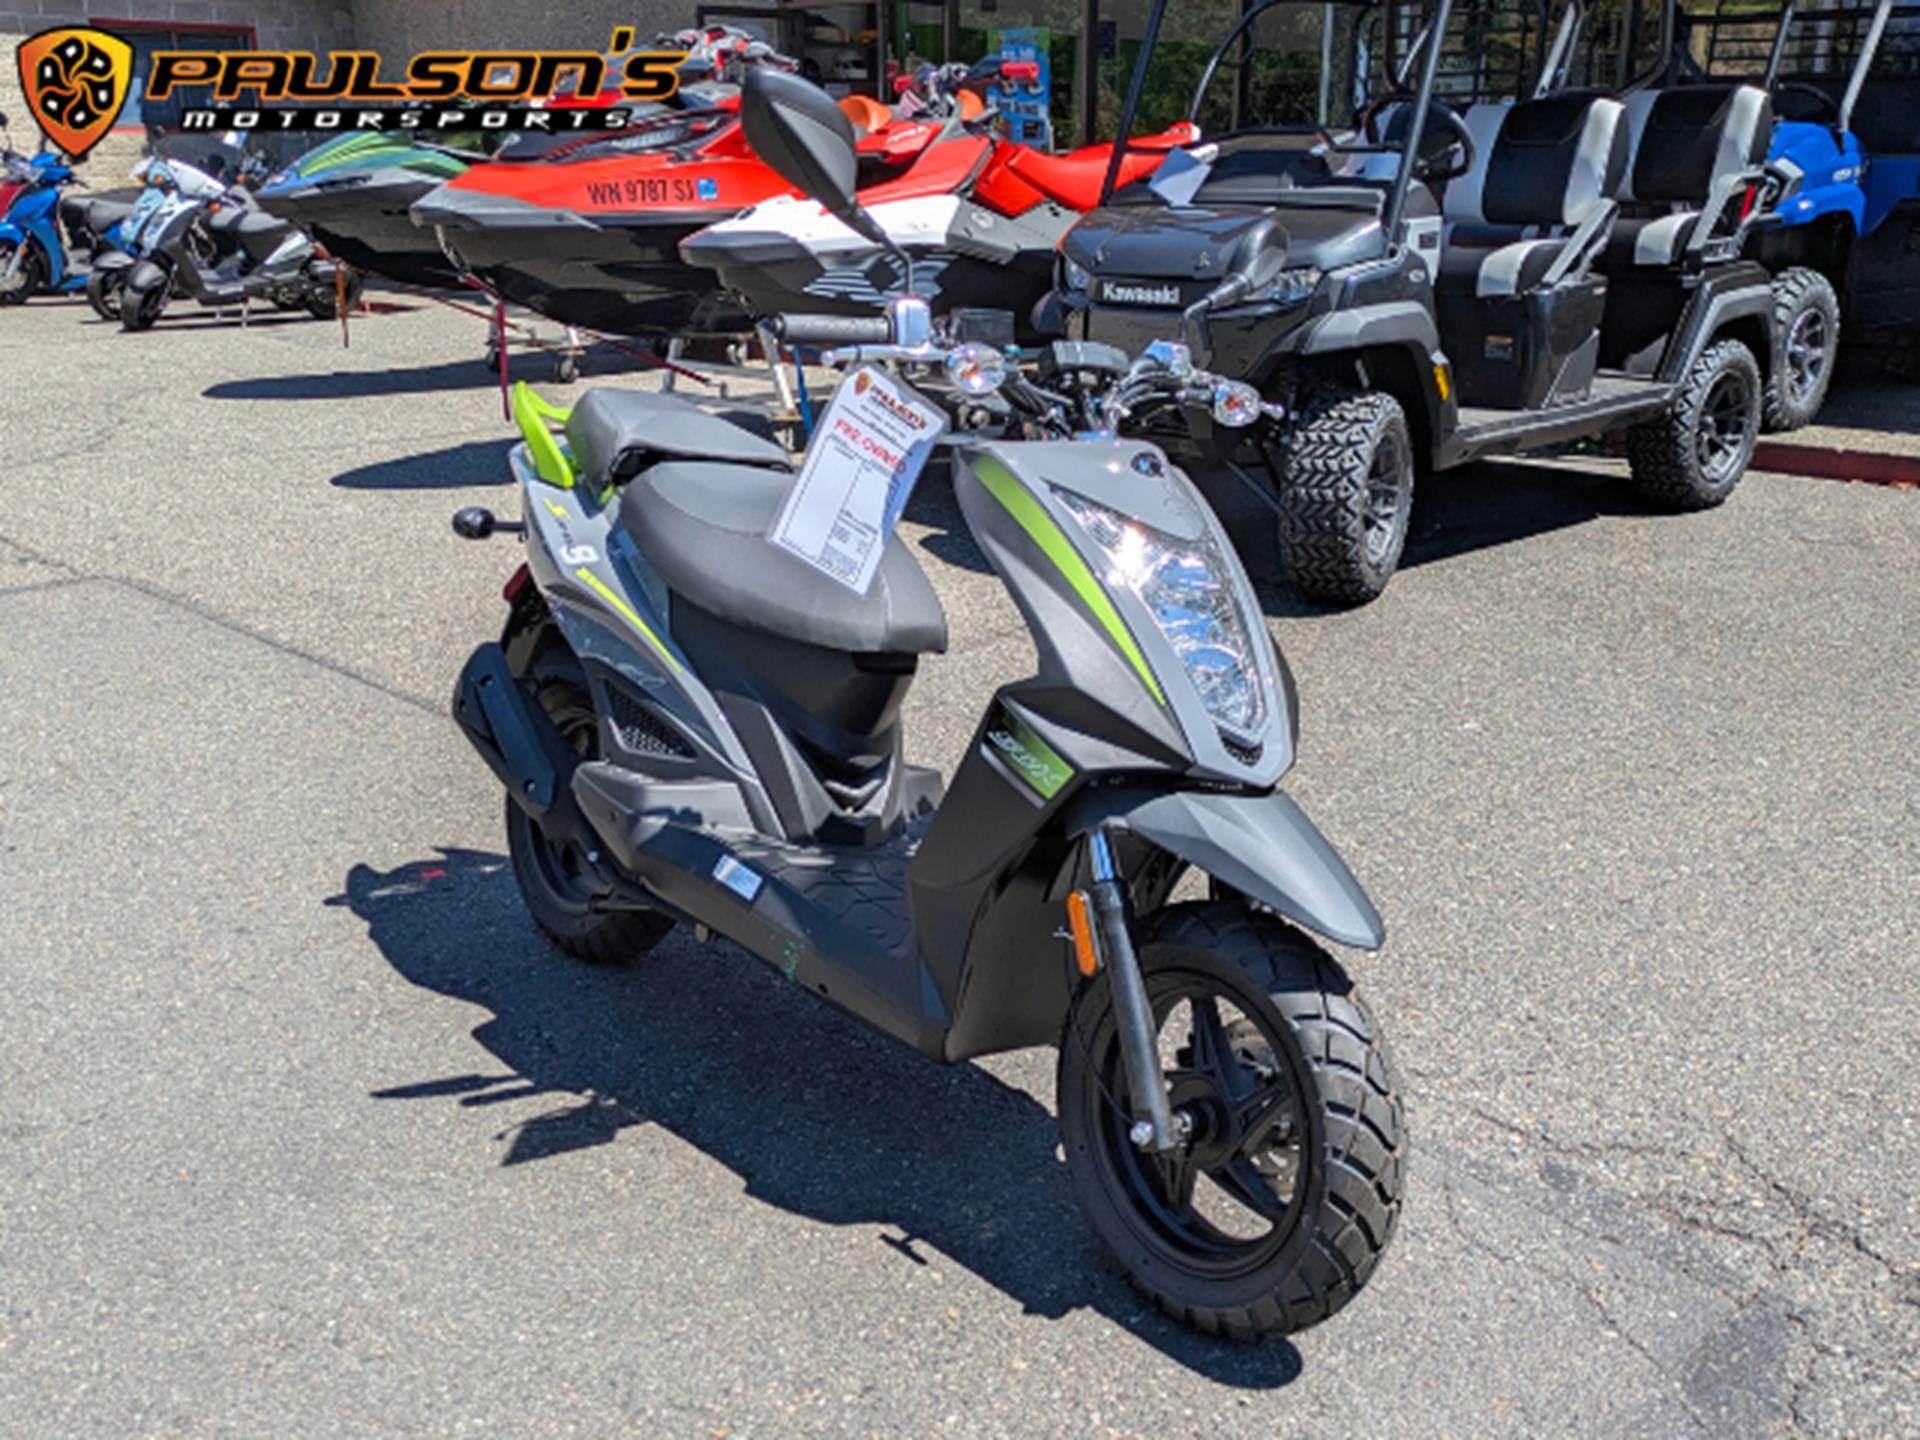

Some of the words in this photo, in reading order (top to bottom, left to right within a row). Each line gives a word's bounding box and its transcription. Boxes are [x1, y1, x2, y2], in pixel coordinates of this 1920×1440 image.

[588, 182, 623, 205] WN
[625, 179, 668, 203] 9787
[1103, 282, 1181, 304] Kawasaki
